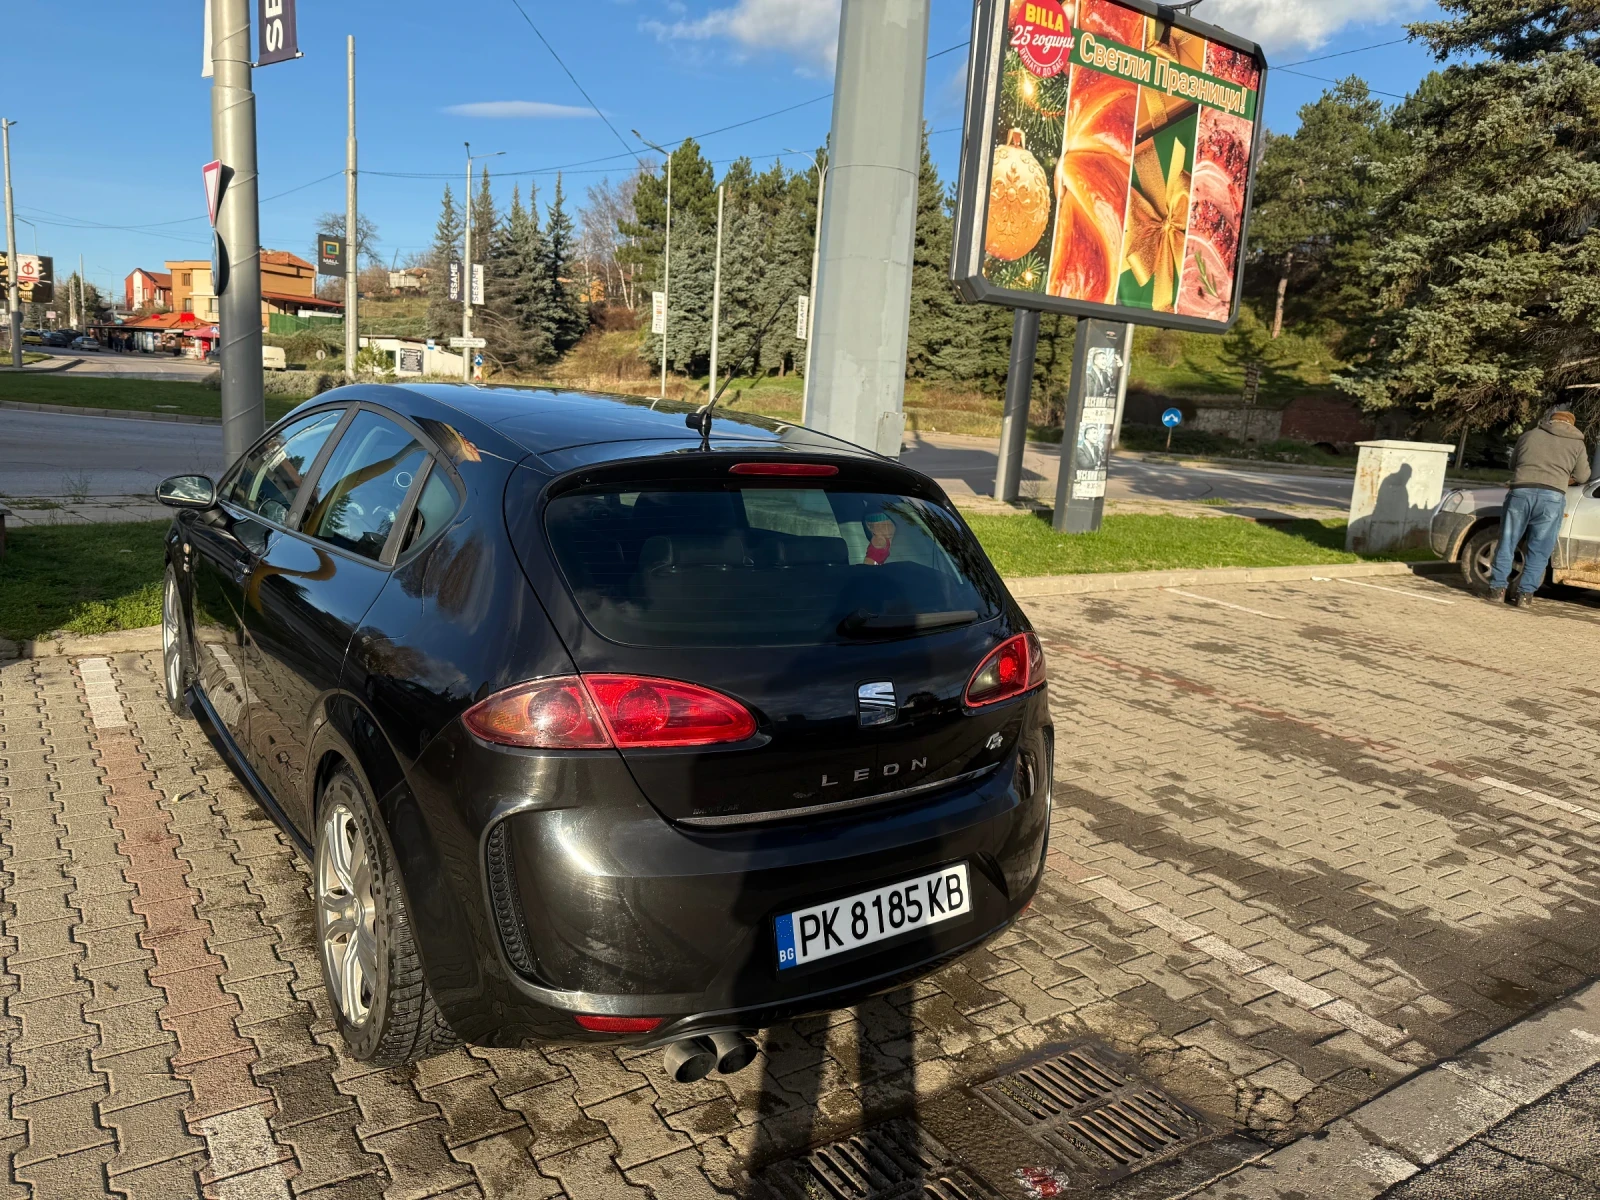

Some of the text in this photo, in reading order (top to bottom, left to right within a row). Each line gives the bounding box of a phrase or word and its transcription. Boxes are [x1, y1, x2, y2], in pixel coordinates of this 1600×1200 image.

[1025, 3, 1064, 33] BILLA
[1010, 25, 1075, 54] 25 години
[1042, 67, 1052, 77] ДО
[1052, 58, 1064, 73] ВАС
[1079, 32, 1248, 115] Светли Празници!
[821, 757, 927, 786] LEON
[799, 873, 964, 957] PK 8185 KB
[779, 947, 795, 963] BG
